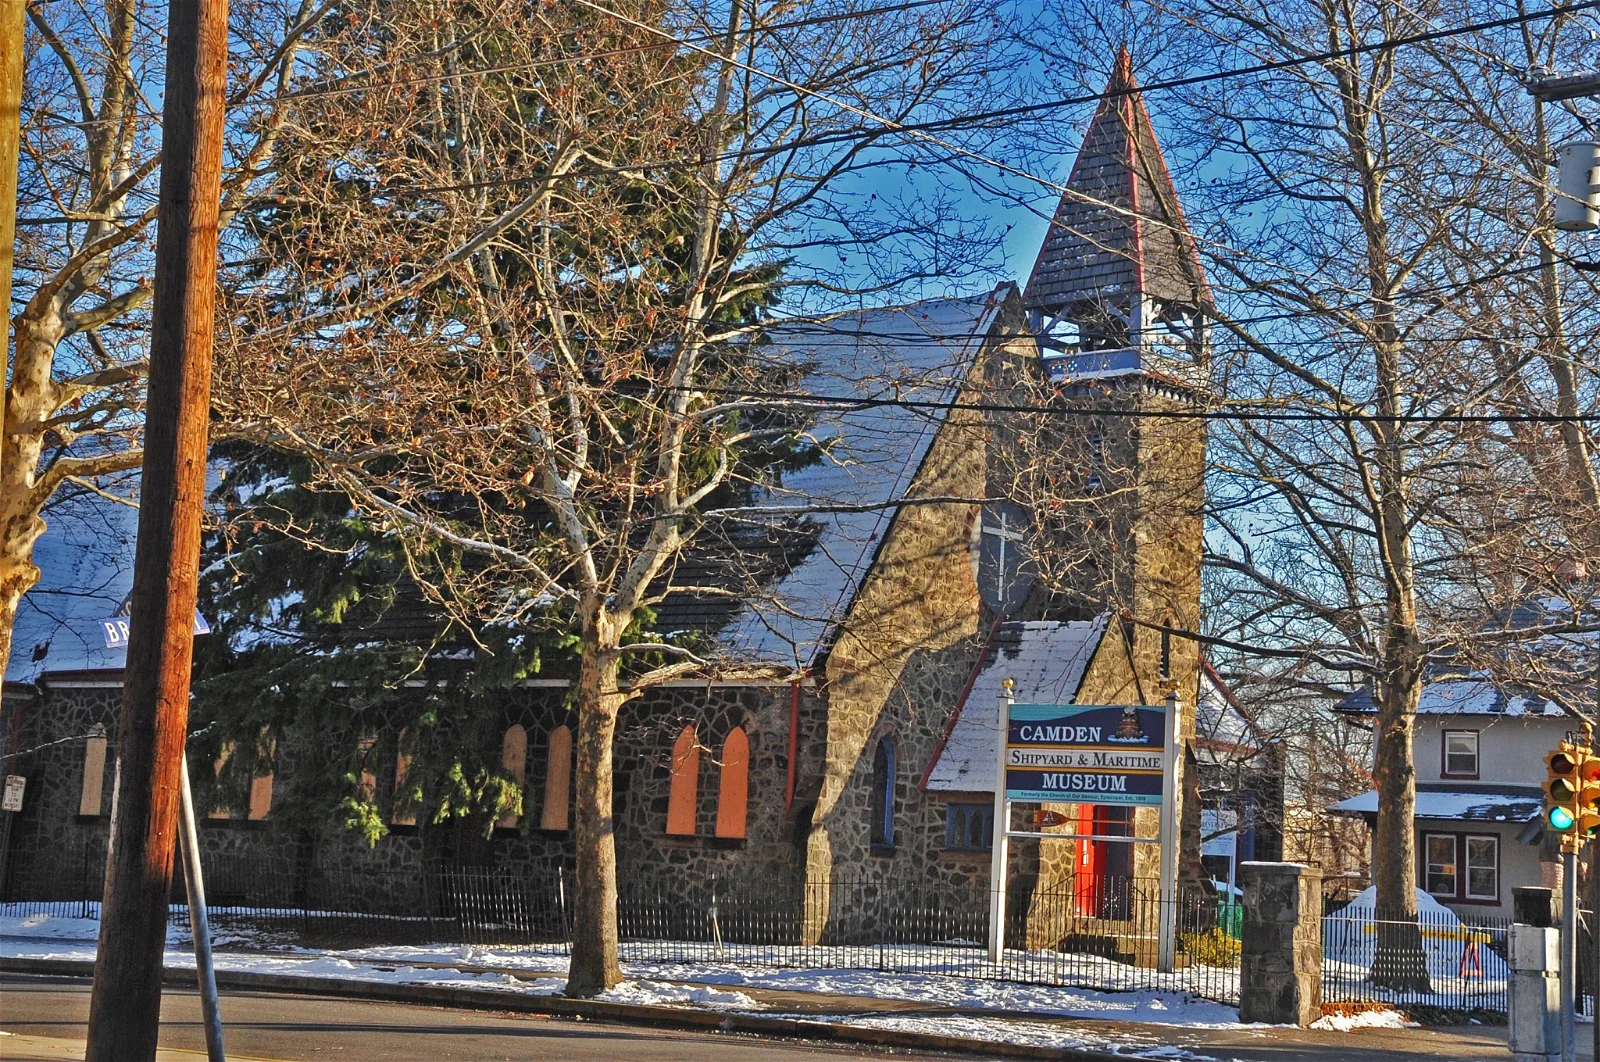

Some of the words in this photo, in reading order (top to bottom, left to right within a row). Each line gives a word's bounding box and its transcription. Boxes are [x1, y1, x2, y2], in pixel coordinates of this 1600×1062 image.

[1020, 725, 1102, 742] CAMDEN
[1012, 750, 1073, 765] SHIPYARD
[1077, 754, 1088, 766] &
[1093, 752, 1160, 768] MARITIME
[1042, 773, 1127, 791] MUSEUM
